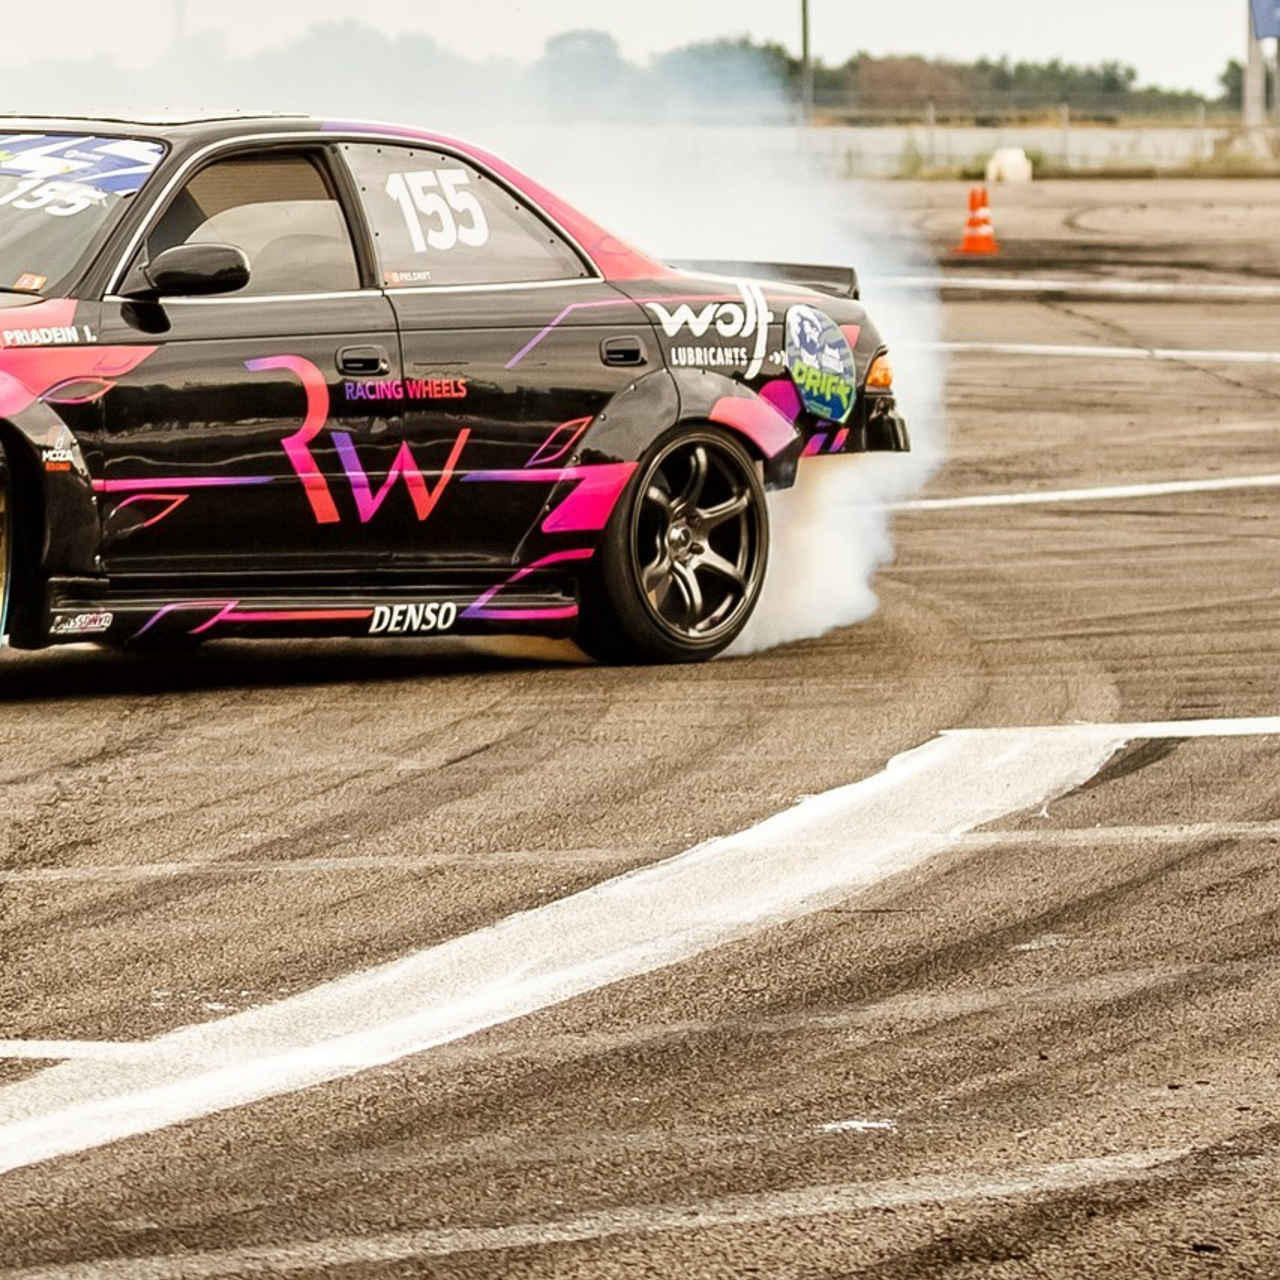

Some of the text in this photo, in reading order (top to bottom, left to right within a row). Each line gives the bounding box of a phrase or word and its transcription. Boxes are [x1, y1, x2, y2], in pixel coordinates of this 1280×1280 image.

[385, 169, 489, 253] 155
[3, 326, 79, 346] PRIADEIN
[671, 347, 748, 367] LUBRICANTS
[345, 378, 468, 401] RACING WHEELS
[369, 602, 457, 634] DENSO
